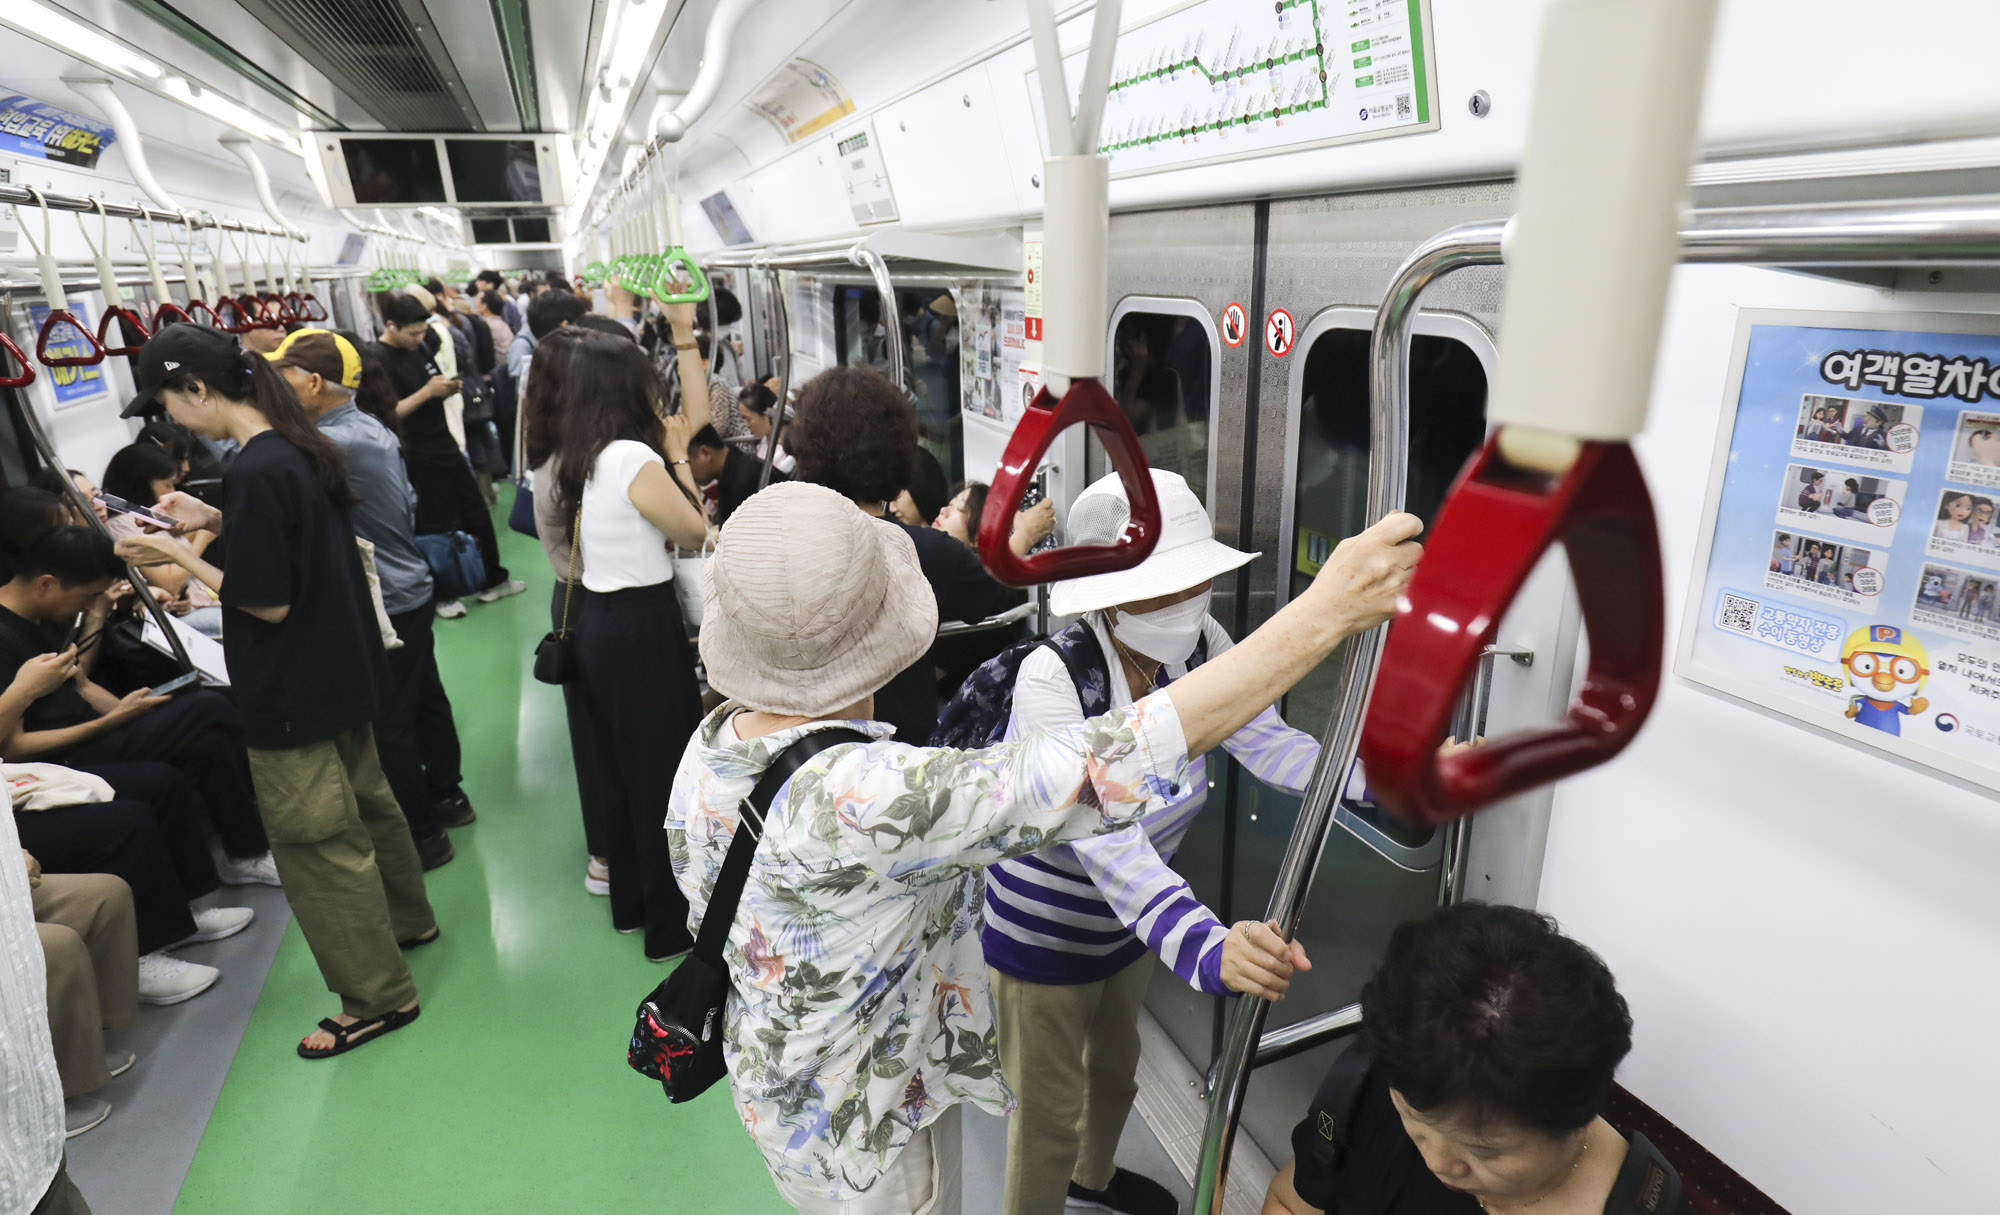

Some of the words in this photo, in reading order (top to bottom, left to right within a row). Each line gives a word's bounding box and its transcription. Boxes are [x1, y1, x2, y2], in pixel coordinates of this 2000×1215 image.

[1761, 607, 1811, 631] 교통약자
[1814, 620, 1840, 640] 전용
[1784, 630, 1825, 653] 동영상
[1937, 660, 1958, 674] 열차
[1957, 652, 1989, 669] 모두의
[1964, 724, 2000, 745] 국토교
